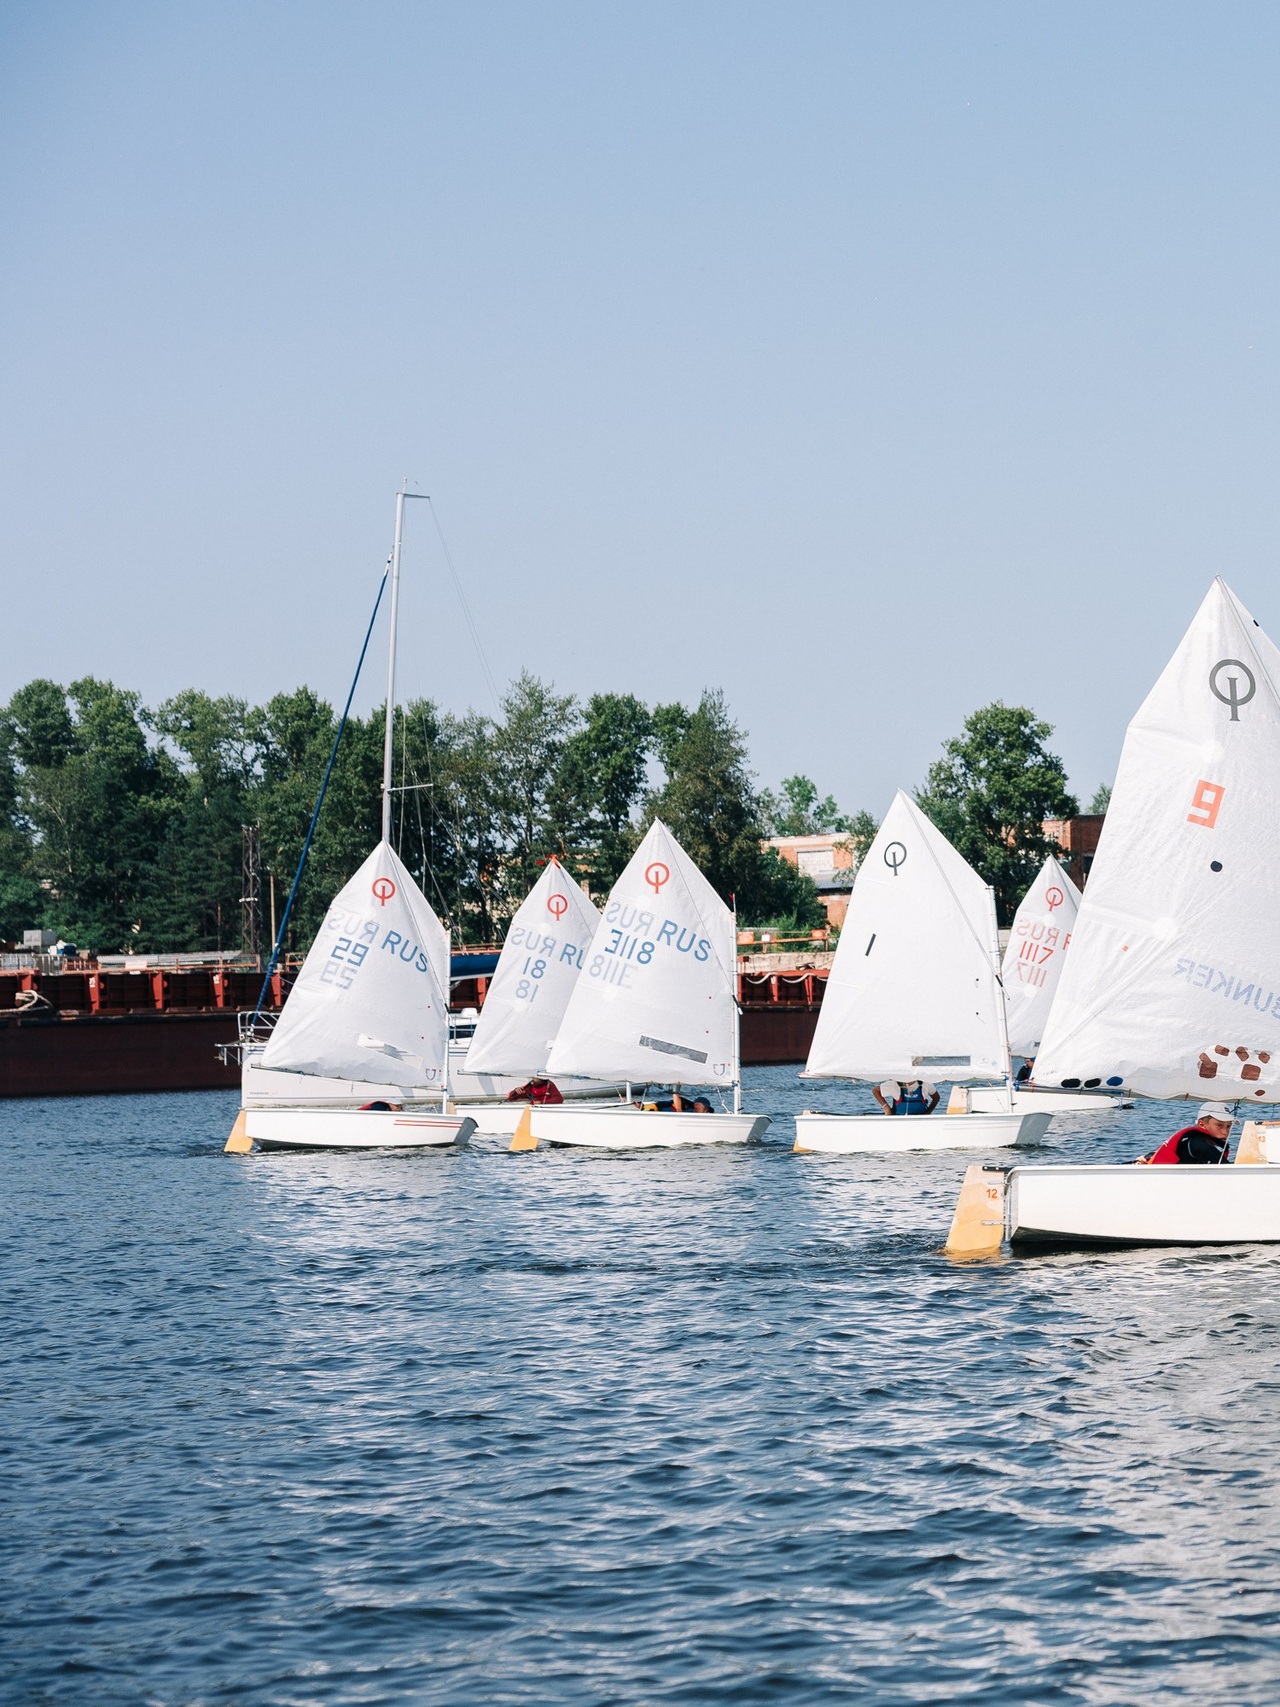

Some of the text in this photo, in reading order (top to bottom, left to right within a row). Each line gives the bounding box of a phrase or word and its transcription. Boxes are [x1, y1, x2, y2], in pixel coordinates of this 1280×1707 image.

[1187, 779, 1226, 829] 9
[331, 937, 370, 967] 29
[381, 930, 428, 973] RUS
[656, 919, 711, 962] RUS
[1019, 940, 1054, 965] 1117
[522, 957, 547, 979] 18
[559, 943, 583, 970] RU
[986, 1188, 998, 1199] 12
